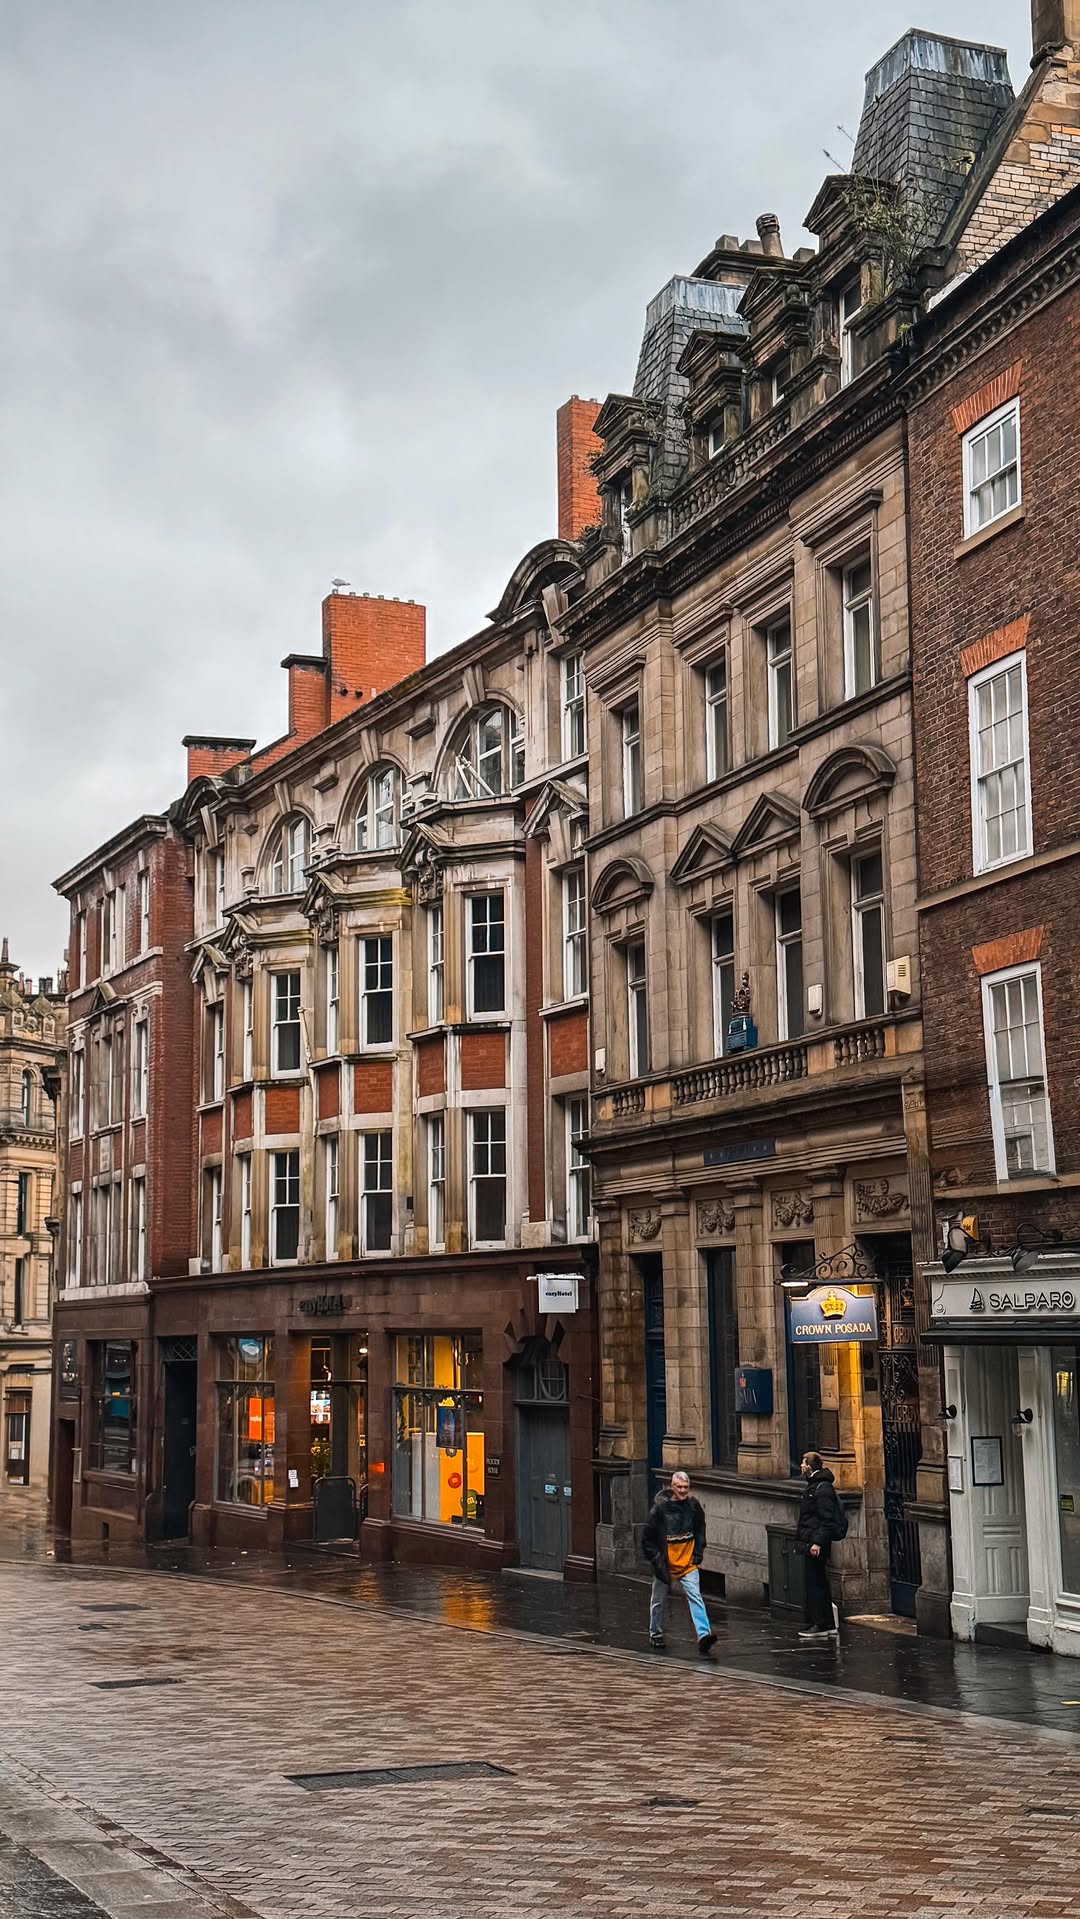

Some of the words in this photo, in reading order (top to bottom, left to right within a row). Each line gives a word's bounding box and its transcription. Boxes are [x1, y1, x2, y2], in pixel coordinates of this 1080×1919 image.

[988, 1290, 1076, 1311] SALPARO
[795, 1324, 832, 1336] CROWN
[835, 1322, 873, 1334] POSADA
